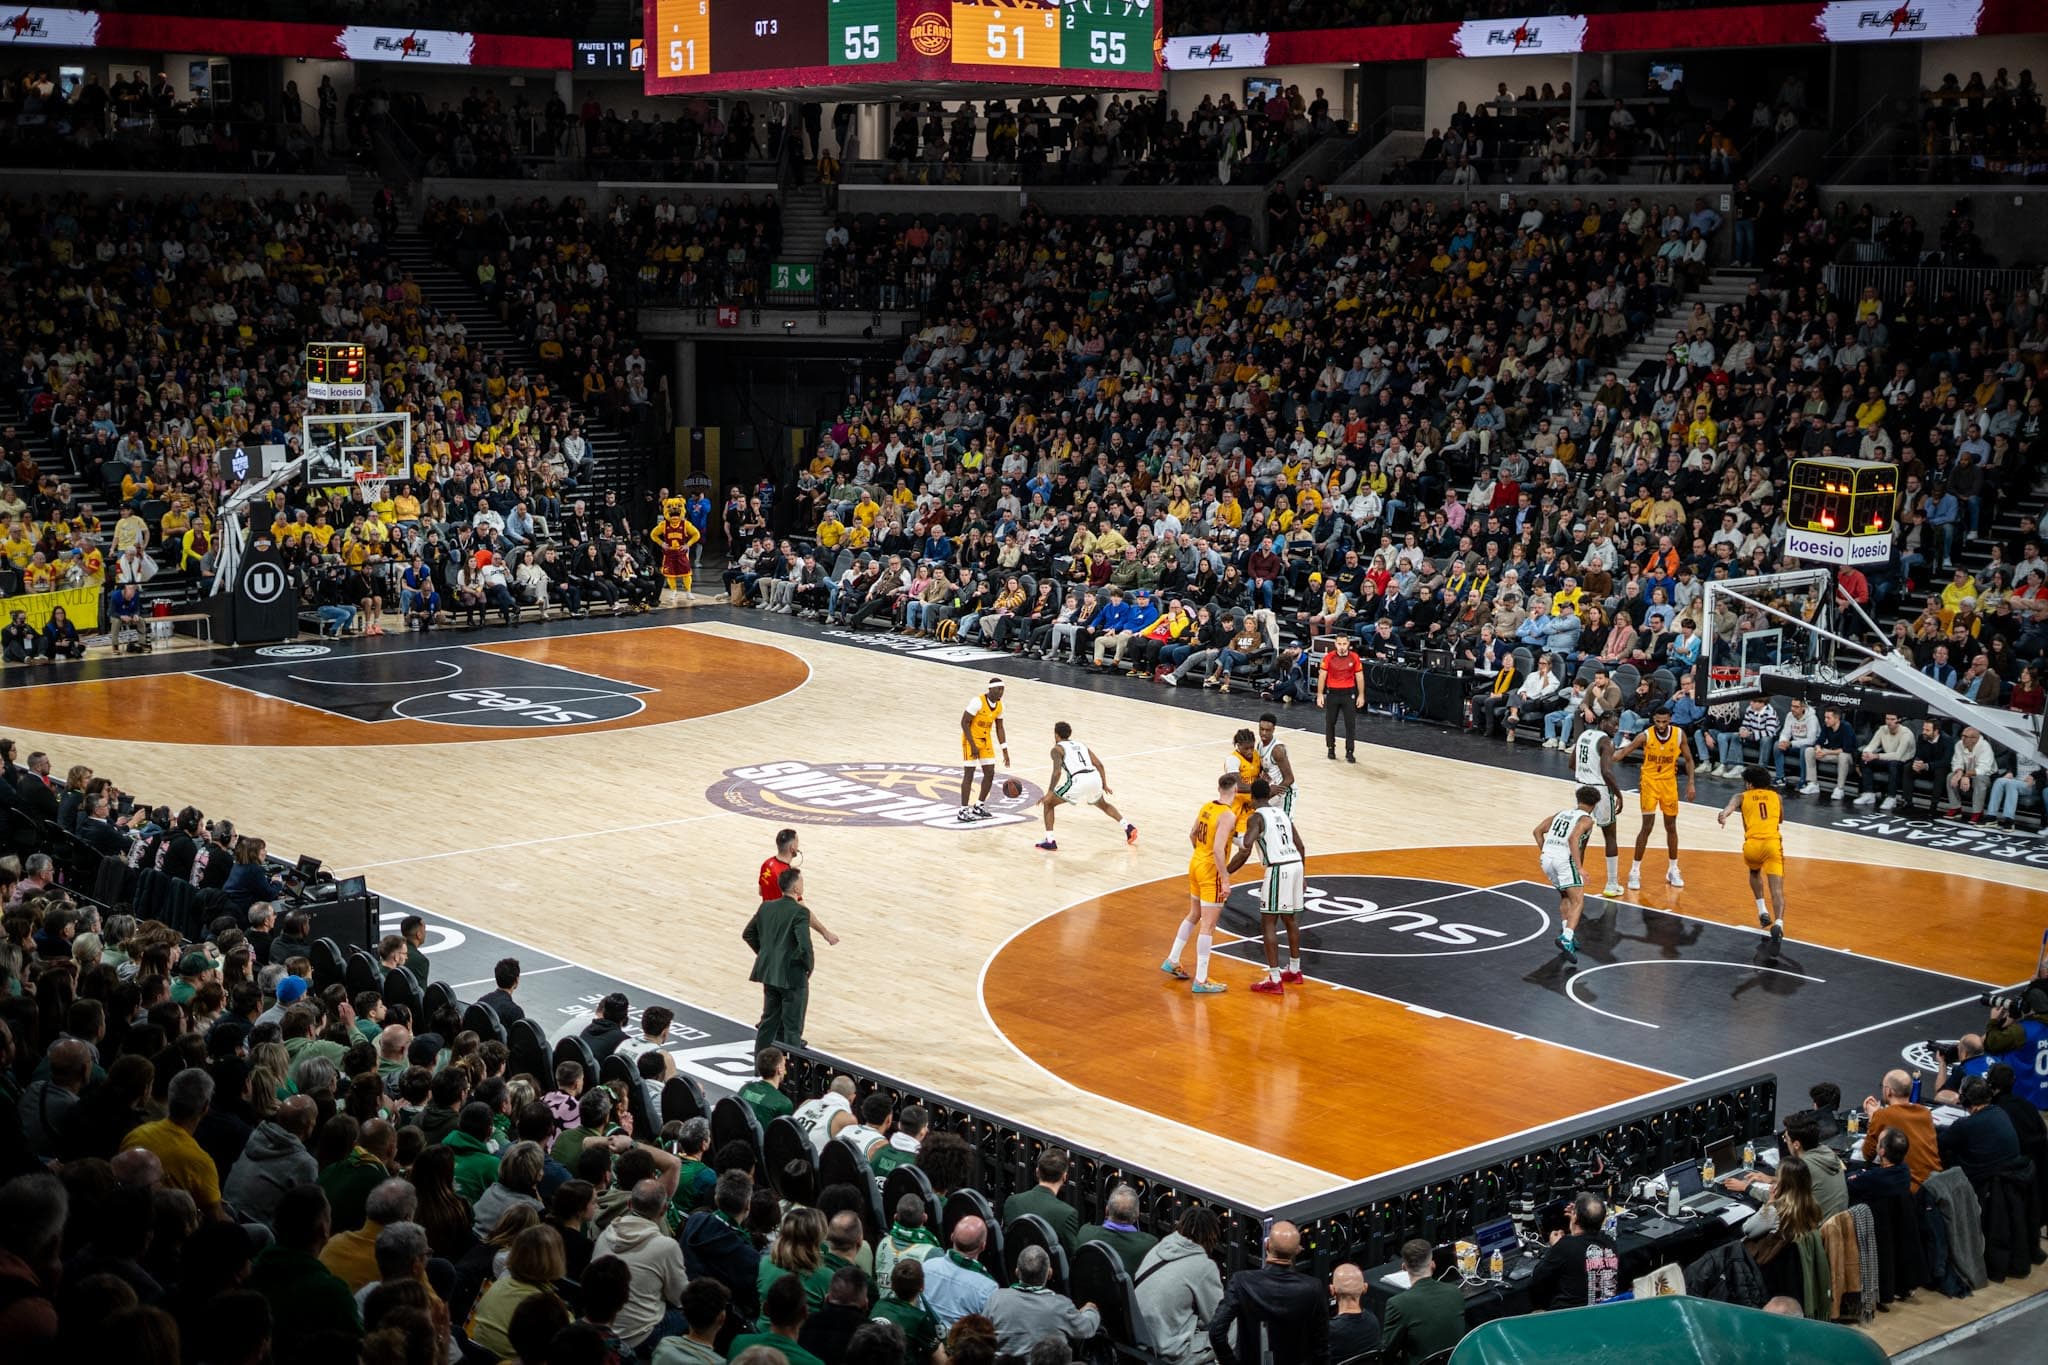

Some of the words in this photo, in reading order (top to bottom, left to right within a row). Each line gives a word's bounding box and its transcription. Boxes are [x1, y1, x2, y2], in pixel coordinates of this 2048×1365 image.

[755, 20, 769, 37] QT
[770, 19, 778, 35] 3
[1045, 13, 1054, 29] 5
[1065, 14, 1075, 30] 2
[578, 42, 606, 51] FAUTES
[612, 42, 626, 51] TM
[844, 24, 880, 60] 55
[986, 24, 1025, 60] 51
[1089, 30, 1127, 65] 55
[586, 53, 596, 66] 5
[615, 53, 623, 66] 1
[669, 38, 695, 72] 51
[330, 387, 363, 398] koesio
[1790, 535, 1844, 559] koesio
[1851, 540, 1888, 560] koesio
[253, 572, 275, 594] U
[447, 690, 598, 723] suez
[1076, 751, 1087, 767] 4
[1758, 802, 1768, 820] 0
[1552, 818, 1570, 838] 43
